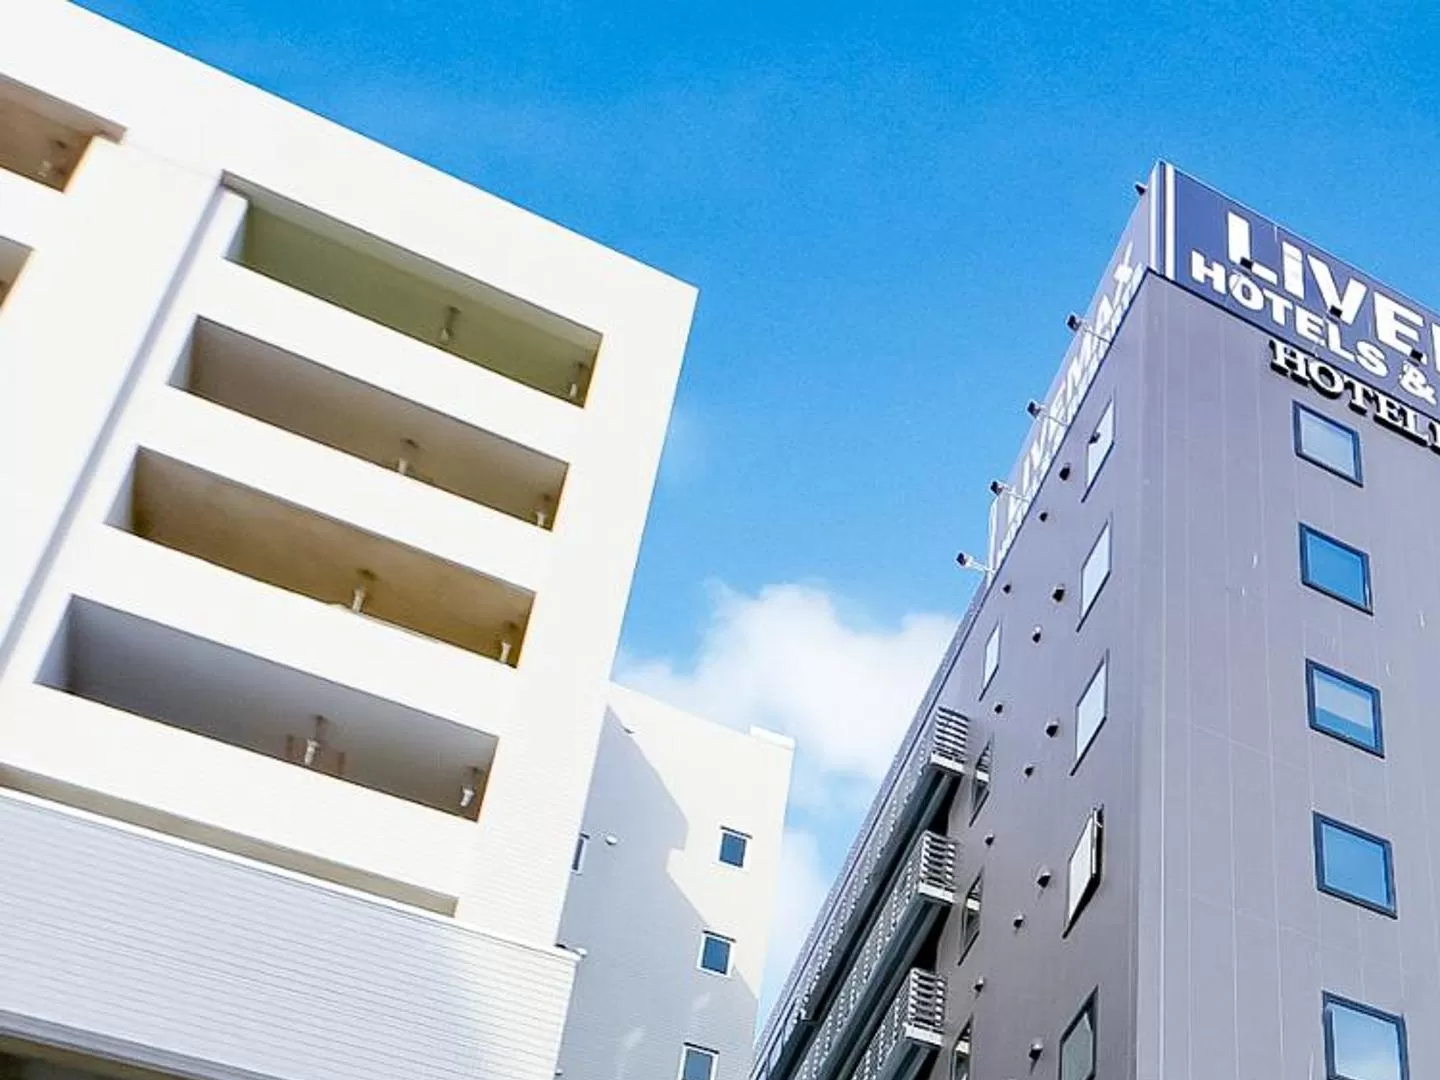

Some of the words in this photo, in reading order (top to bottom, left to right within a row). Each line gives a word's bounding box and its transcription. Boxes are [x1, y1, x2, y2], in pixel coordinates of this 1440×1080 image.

[1191, 250, 1389, 377] HOTELS
[1400, 360, 1436, 406] &
[1269, 339, 1430, 446] HOTEL
